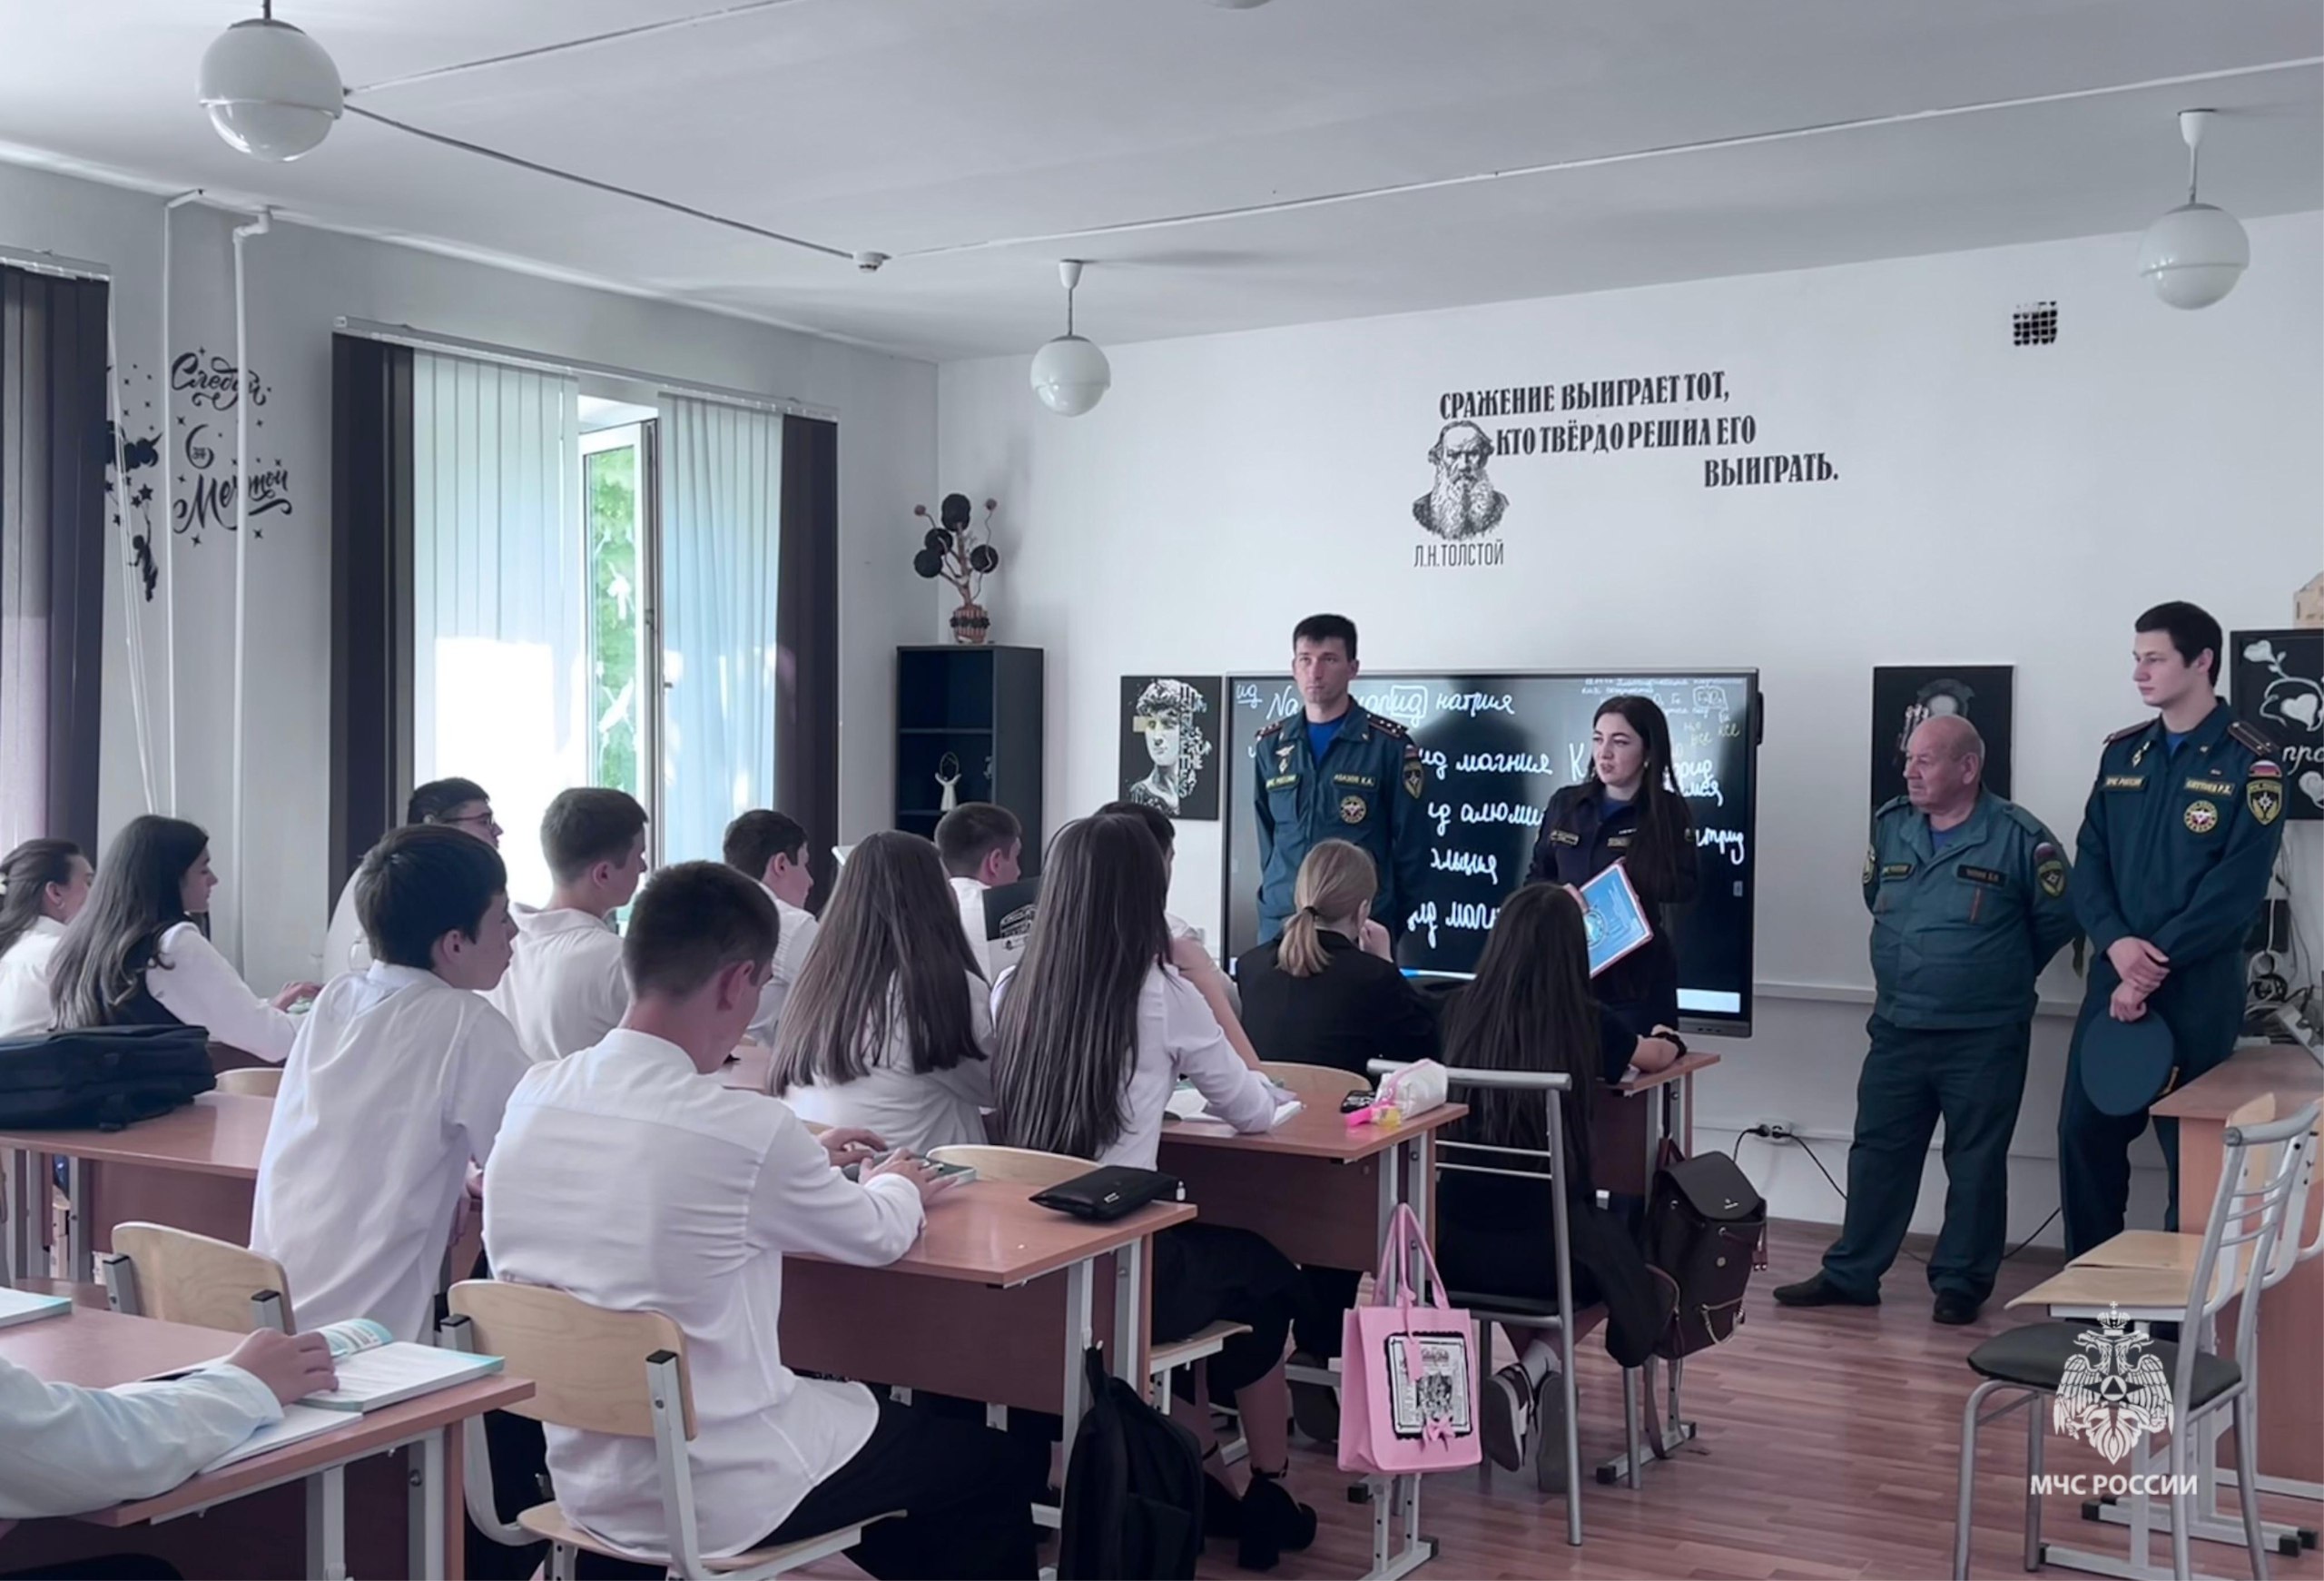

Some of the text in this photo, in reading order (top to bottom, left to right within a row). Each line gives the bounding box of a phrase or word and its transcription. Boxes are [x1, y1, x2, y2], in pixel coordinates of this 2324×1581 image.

[1440, 371, 1729, 420] СРАЖЕНИЕ ВЫИГРАЕТ ТОТ,
[1496, 415, 1757, 456] КТО ТВЁРДО РЕШИЛ ЕГО
[1704, 453, 1839, 488] ВЫИГРАТЬ.
